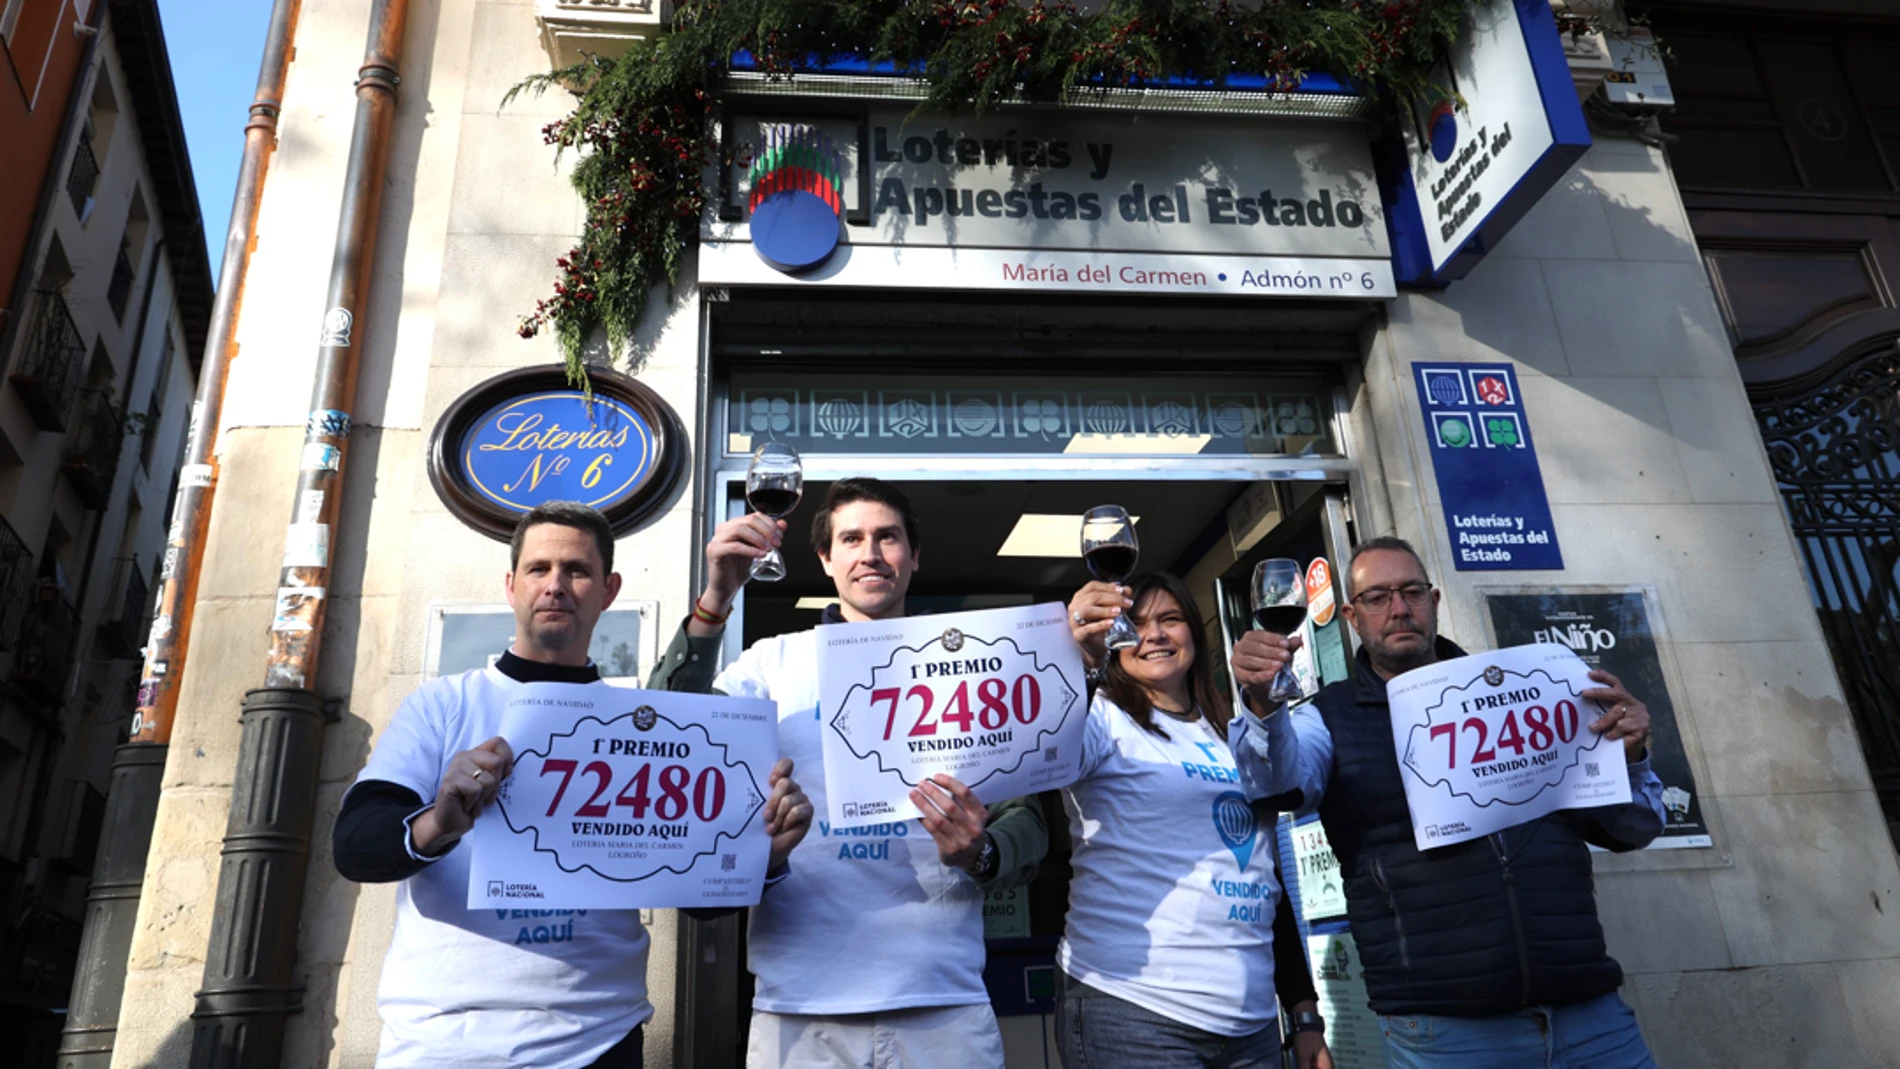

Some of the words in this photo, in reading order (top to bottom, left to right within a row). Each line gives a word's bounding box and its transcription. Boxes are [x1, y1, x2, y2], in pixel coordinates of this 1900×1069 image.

[874, 127, 1072, 168] Loterías
[1086, 142, 1112, 180] y
[1430, 138, 1478, 201] Loterías
[1478, 125, 1487, 149] y
[1437, 152, 1490, 221] Apuestas
[1491, 121, 1512, 157] del
[874, 177, 1102, 226] Apuestas
[1118, 182, 1191, 223] del
[1206, 188, 1364, 228] Estado
[1440, 191, 1481, 243] Estado
[1002, 263, 1069, 282] María
[1077, 264, 1111, 283] del
[1119, 266, 1207, 286] Carmen
[1241, 269, 1322, 289] Admón
[1361, 272, 1375, 290] 6
[581, 453, 613, 489] 6
[1453, 513, 1512, 528] Loterías
[1514, 516, 1524, 530] y
[1459, 531, 1525, 548] Apuestas
[1526, 530, 1549, 545] del
[1461, 548, 1511, 562] Estado
[1550, 623, 1616, 652] Niño
[925, 656, 1003, 678] PREMIO
[556, 699, 594, 709] NAVIDAD
[869, 673, 1042, 741] 72480
[1473, 686, 1541, 711] PREMIO
[907, 736, 974, 753] VENDIDO
[978, 727, 1013, 748] AQUÍ
[1429, 699, 1579, 769] 72480
[608, 738, 691, 759] PREMIO
[1181, 761, 1240, 784] PREM
[1472, 757, 1528, 778] VENDIDO
[1531, 746, 1559, 766] AQUÍ
[539, 759, 726, 822] 72480
[859, 801, 888, 810] LOTERÍA
[859, 806, 896, 816] NACIONAL
[572, 822, 645, 837] VENDIDO
[647, 821, 689, 841] AQUÍ
[608, 850, 648, 859] LOGROÑO
[635, 842, 649, 850] DEL
[651, 842, 684, 850] CARMEN
[837, 838, 890, 861] AQUÍ
[505, 890, 545, 899] NACIONAL
[506, 882, 537, 891] LOTERÍA
[1212, 880, 1271, 900] VENDIDO
[1228, 903, 1262, 923] AQUÍ
[514, 918, 574, 945] AQUÍ
